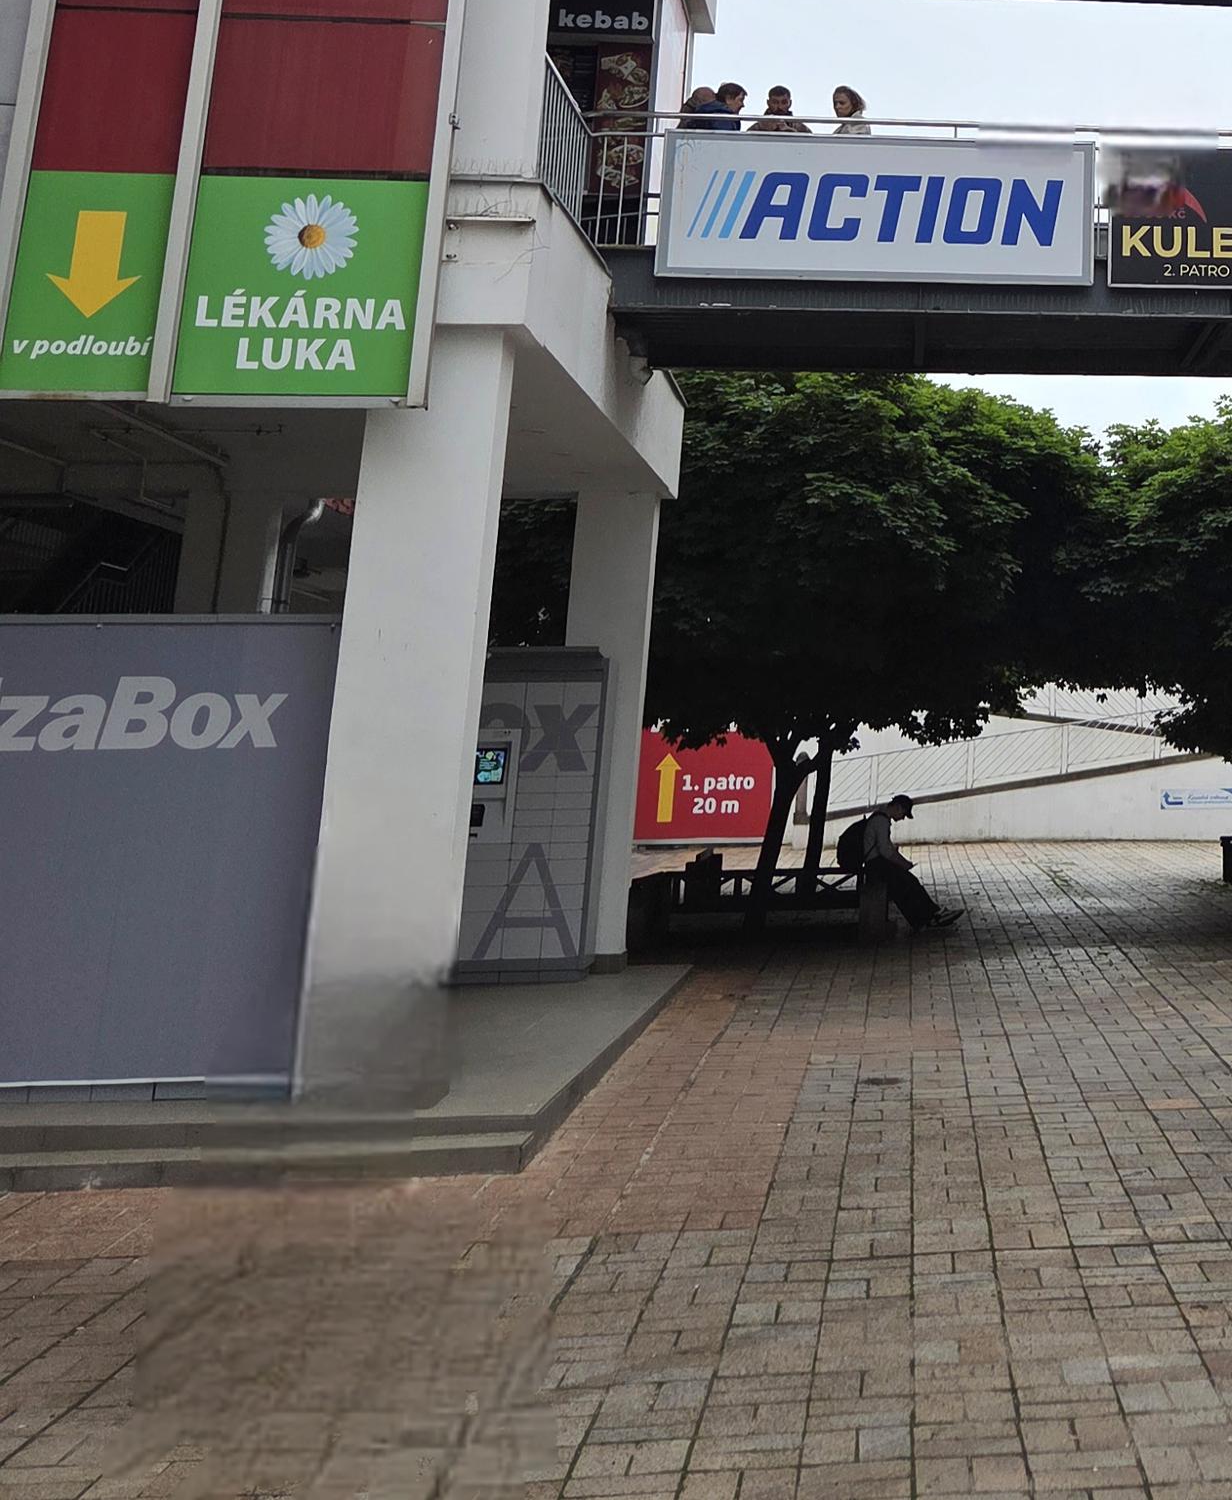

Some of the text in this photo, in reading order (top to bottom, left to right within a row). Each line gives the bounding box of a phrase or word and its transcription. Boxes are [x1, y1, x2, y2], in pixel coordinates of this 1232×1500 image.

[558, 8, 649, 31] kebab
[739, 171, 1064, 247] ACTION
[1163, 264, 1175, 277] 2.
[1180, 264, 1230, 278] PATRO
[195, 288, 406, 330] LÉKÁRNA
[12, 334, 152, 360] v podloubí
[235, 337, 355, 371] LUKA
[0, 676, 288, 752] zaBox
[682, 773, 755, 794] 1. patro
[692, 798, 740, 814] 20 m
